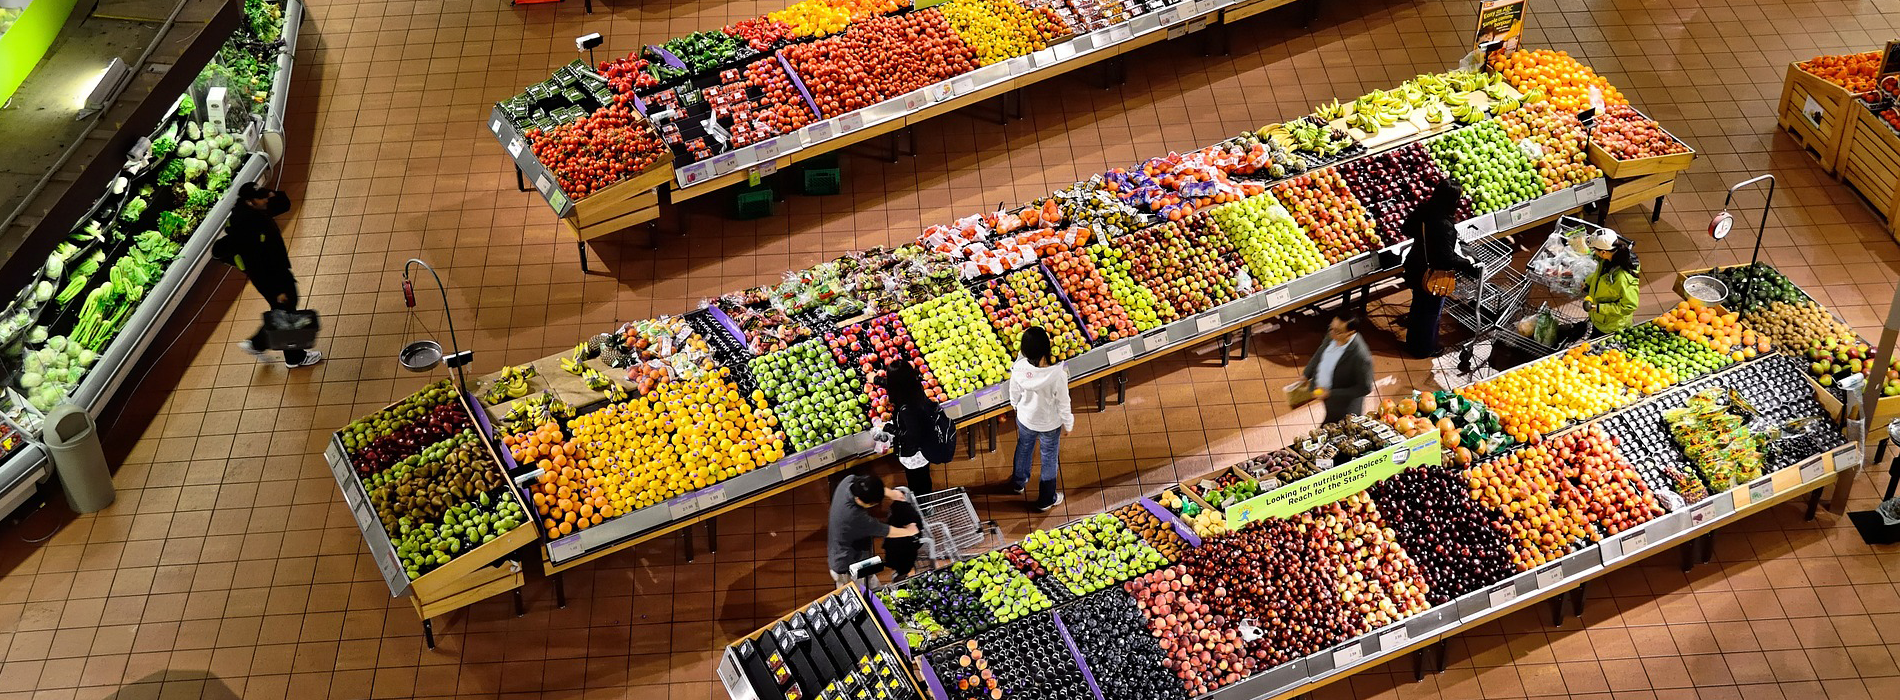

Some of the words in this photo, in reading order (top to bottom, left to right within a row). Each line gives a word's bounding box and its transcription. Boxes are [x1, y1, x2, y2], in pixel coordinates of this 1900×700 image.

[1266, 490, 1298, 506] Looking
[1299, 483, 1311, 493] for
[1312, 468, 1353, 488] nutritious
[1354, 454, 1388, 473] choices?
[1288, 492, 1313, 505] Reach
[1314, 486, 1326, 496] for
[1328, 480, 1341, 491] the
[1343, 470, 1368, 484] Stars!
